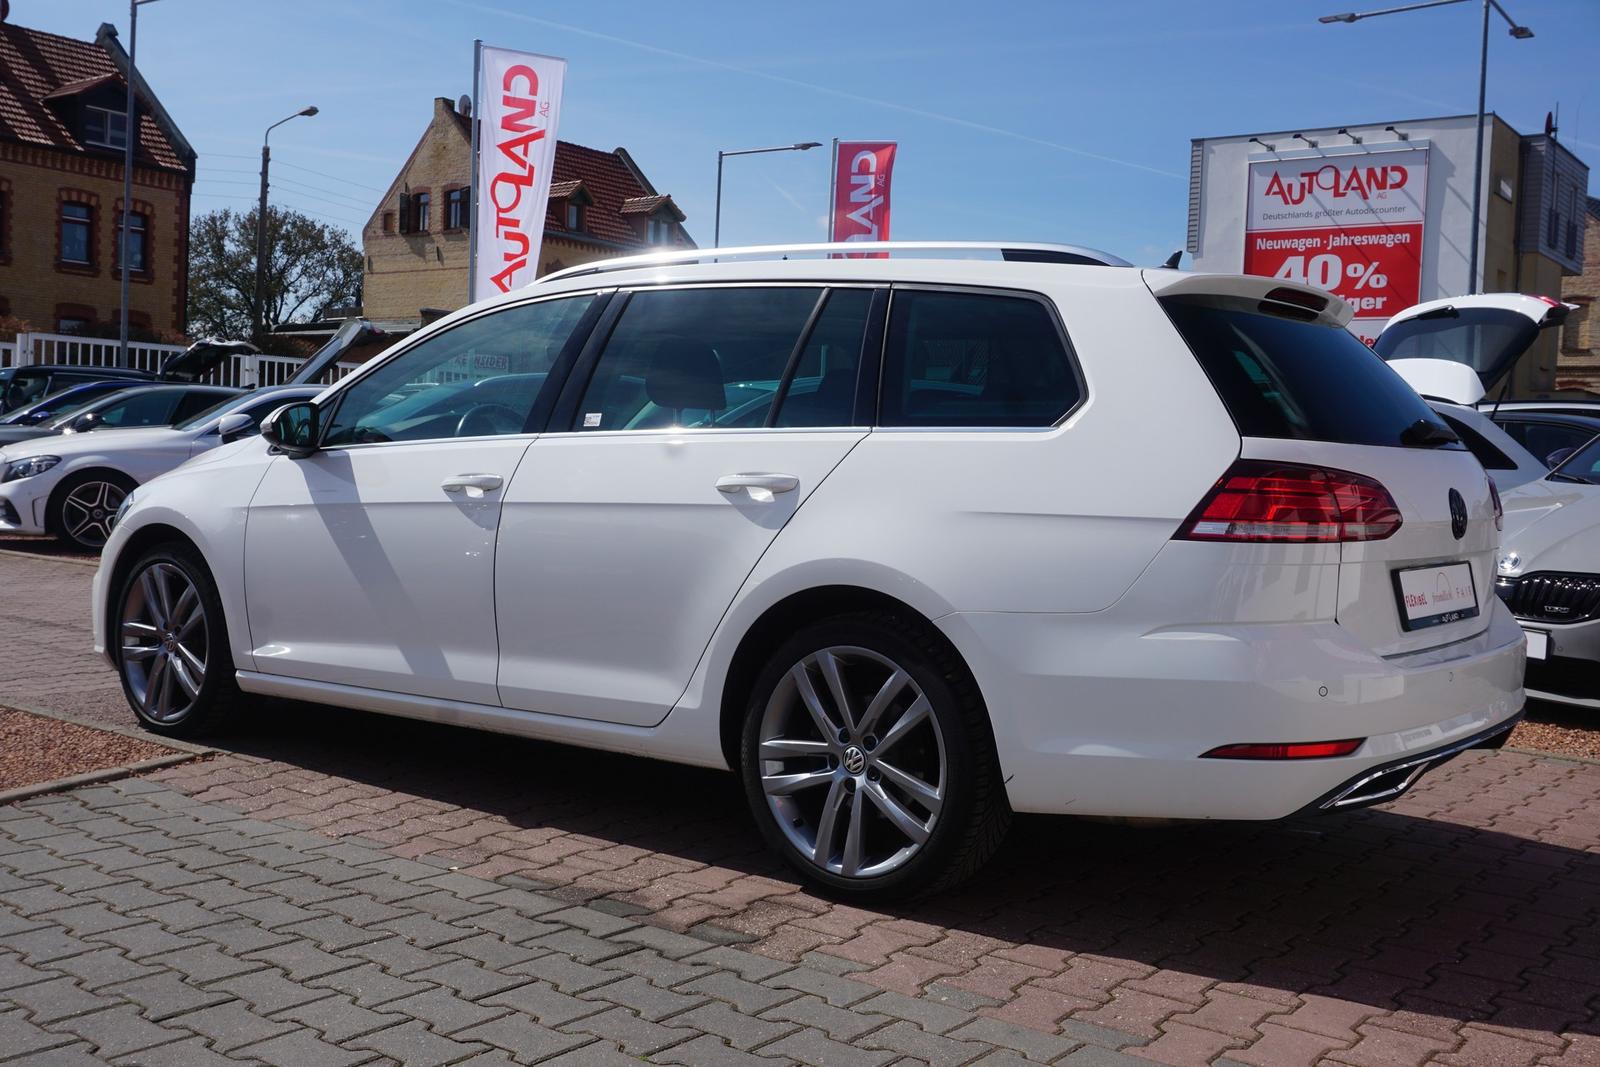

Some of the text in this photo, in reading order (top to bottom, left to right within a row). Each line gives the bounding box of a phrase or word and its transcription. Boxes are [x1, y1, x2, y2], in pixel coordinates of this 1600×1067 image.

[539, 101, 549, 118] AG
[490, 64, 546, 293] AUTOLAND
[1264, 165, 1409, 206] AUTOLAND
[846, 150, 884, 242] LAND
[1376, 192, 1387, 200] AG
[1262, 205, 1407, 221] Deutschlands größter Autodiscounter
[1256, 232, 1411, 251] Neuwagen Jahreswagen
[1346, 296, 1387, 313] ger
